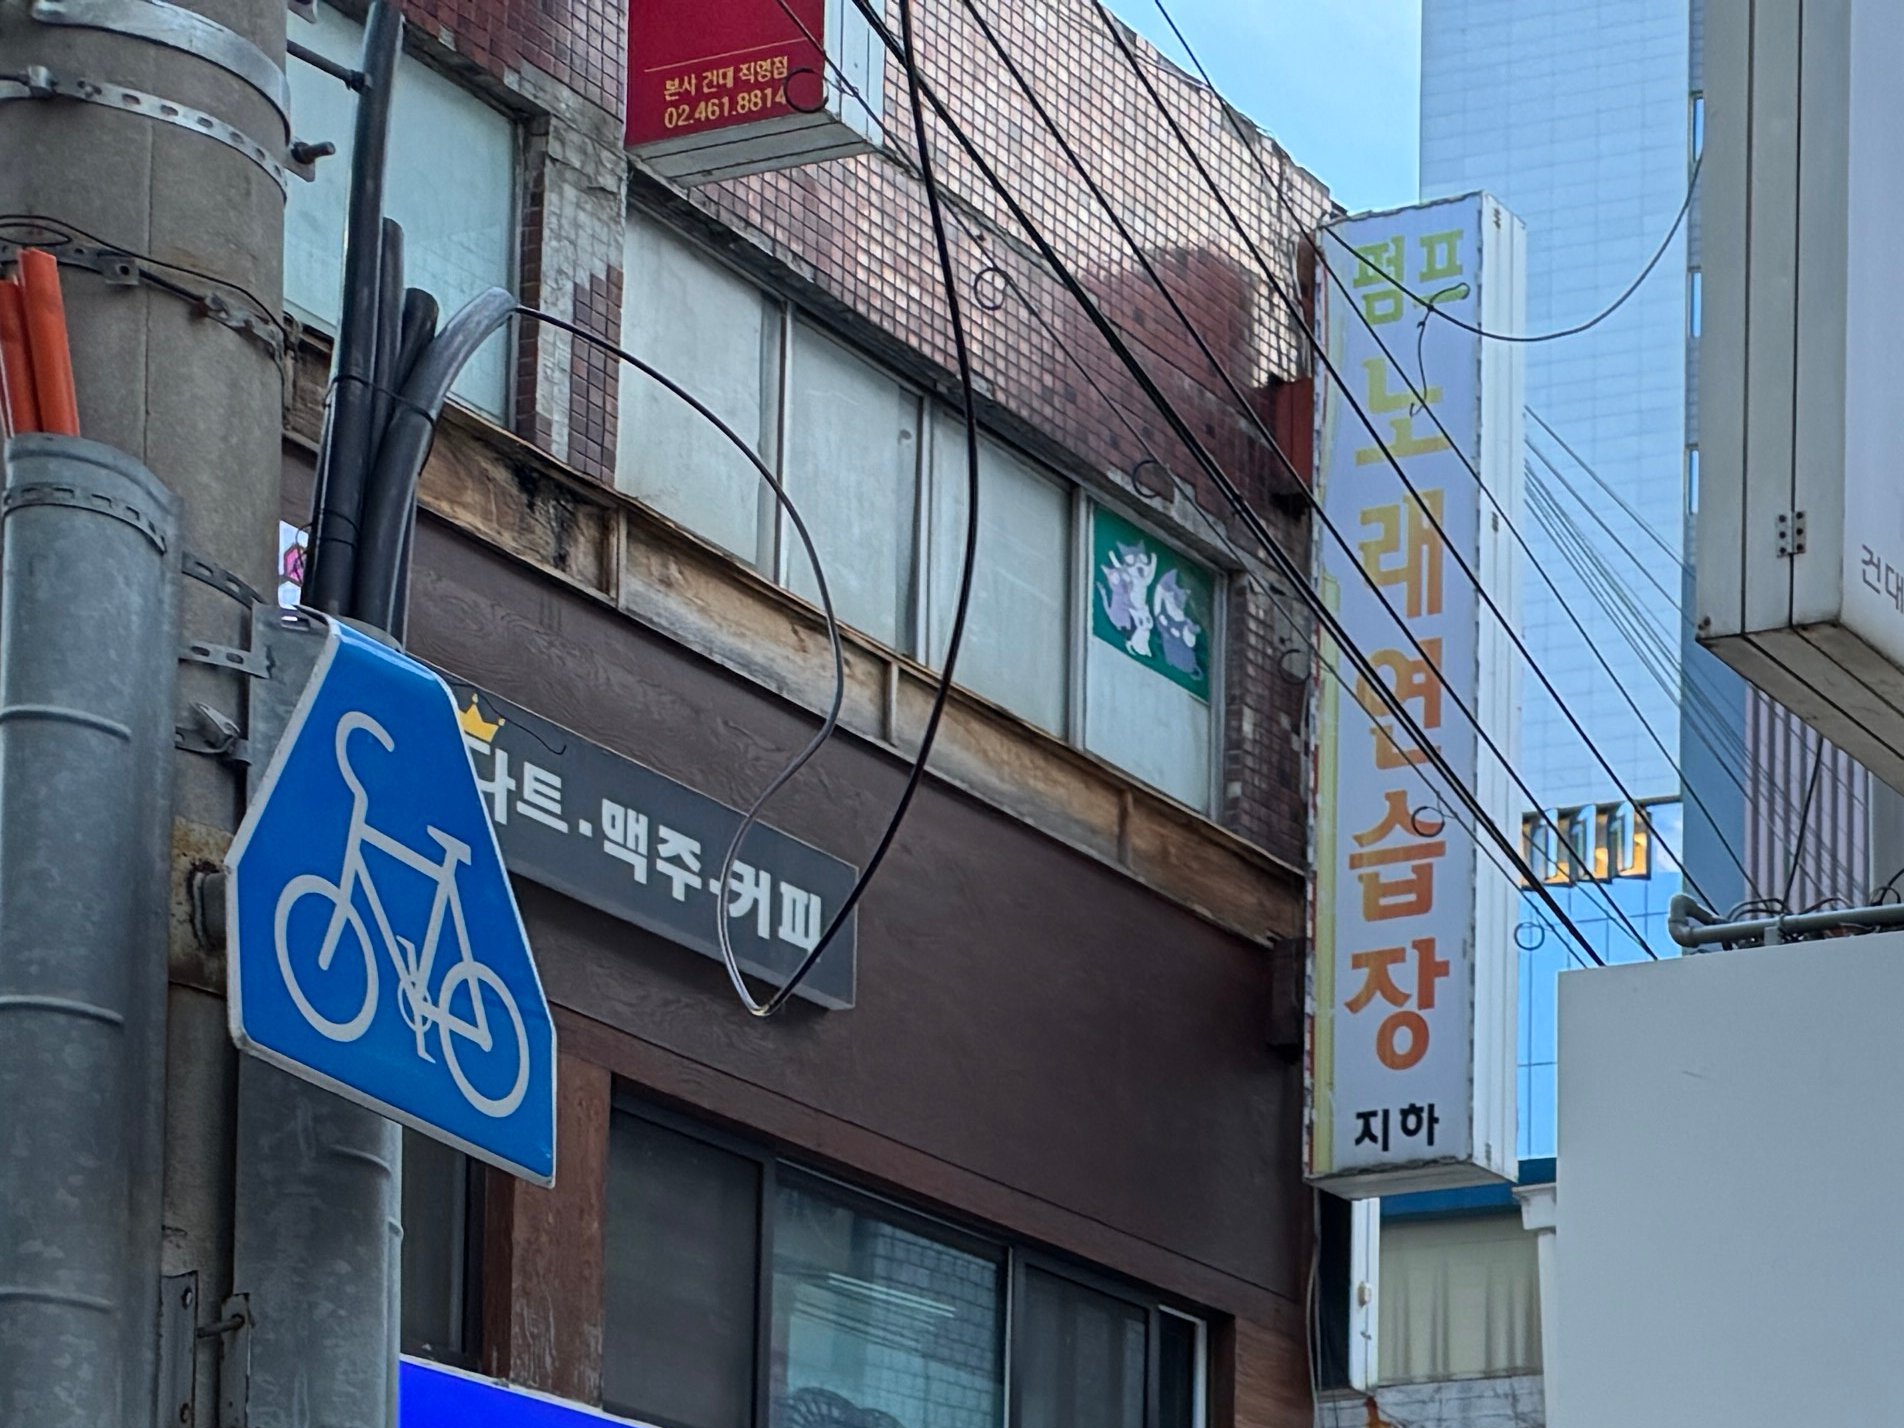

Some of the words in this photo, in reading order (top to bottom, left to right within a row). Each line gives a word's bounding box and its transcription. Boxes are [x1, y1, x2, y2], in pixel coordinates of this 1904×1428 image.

[664, 74, 696, 101] 본사
[702, 66, 734, 93] 건대
[739, 55, 788, 84] 직영점
[664, 87, 787, 129] 02.461.8814
[1353, 230, 1469, 326] 펌프
[1354, 1102, 1440, 1153] 지하
